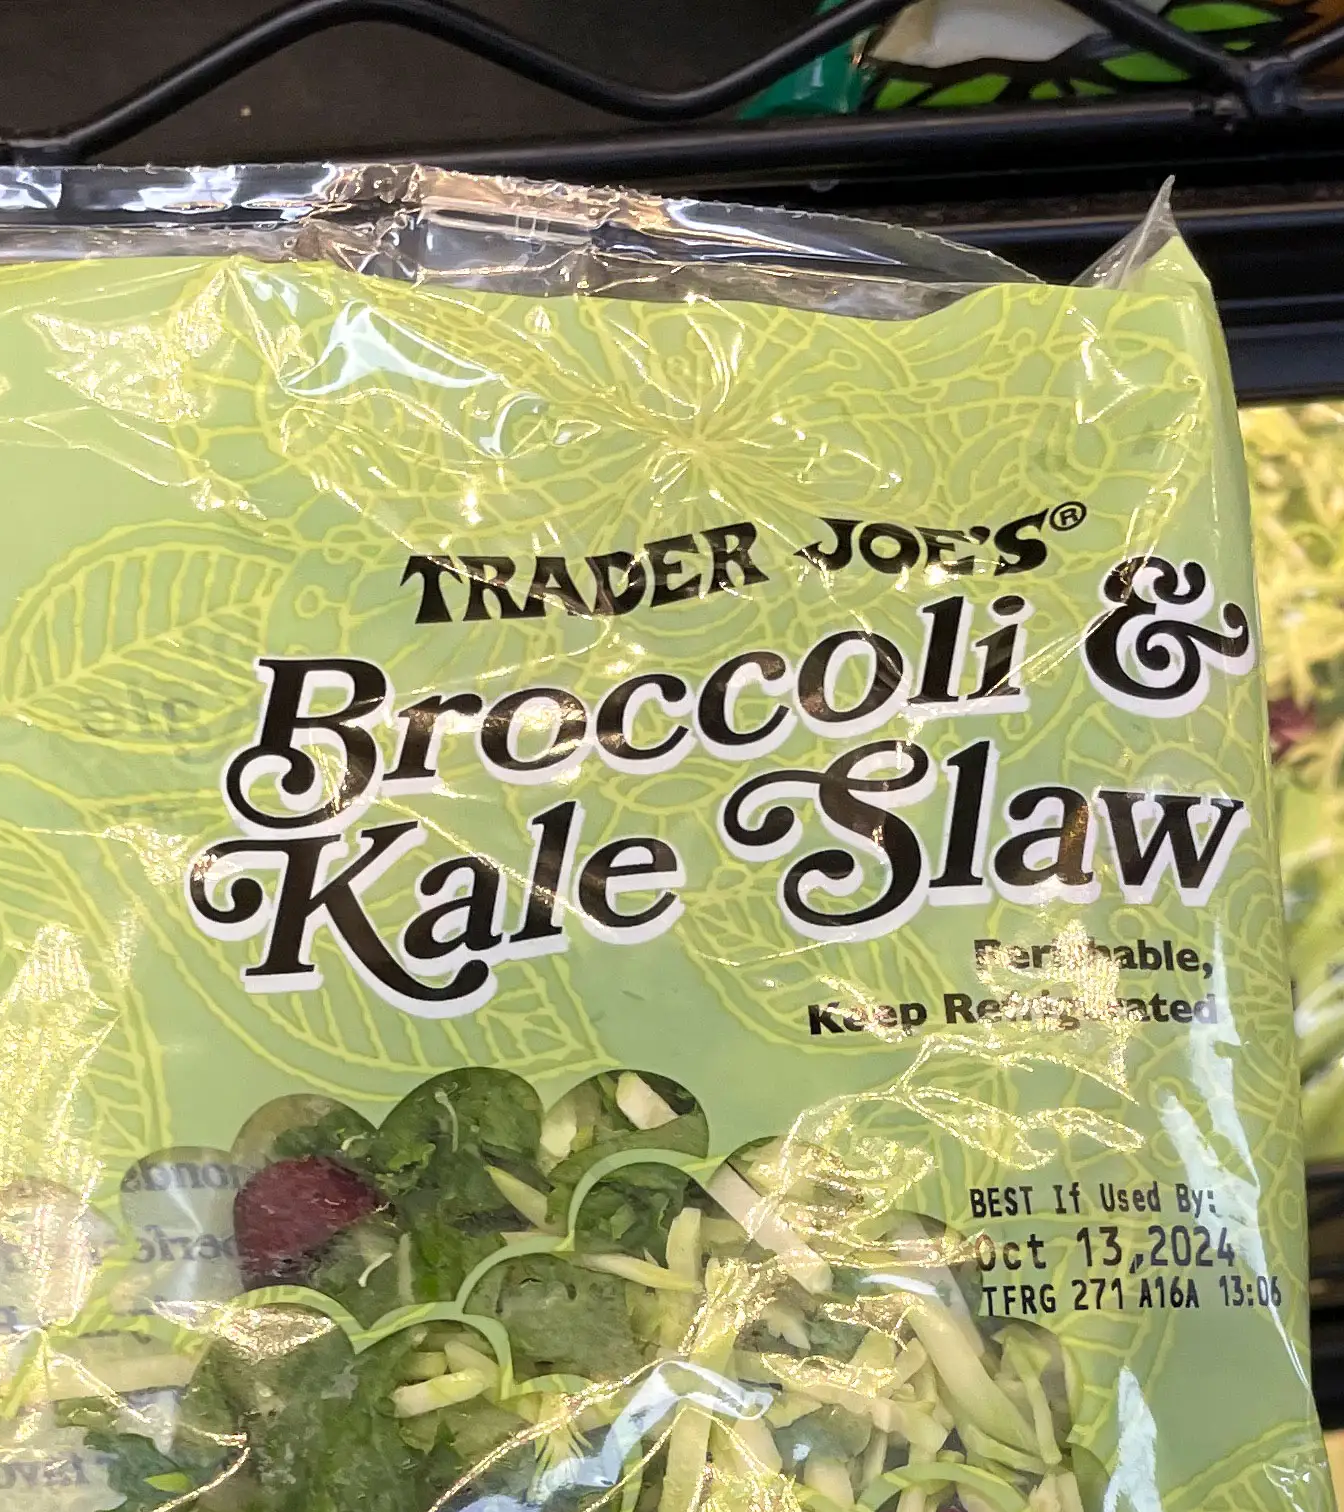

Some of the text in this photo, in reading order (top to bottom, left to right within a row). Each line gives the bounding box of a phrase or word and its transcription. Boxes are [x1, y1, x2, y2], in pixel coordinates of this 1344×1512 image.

[401, 521, 770, 625] TRADER
[226, 556, 1250, 830] Broccoli &
[193, 739, 1246, 1003] Kale Slaw
[973, 939, 1213, 979] Perable,
[808, 999, 928, 1036] Keep
[969, 1181, 1216, 1218] BEST If Used By:
[976, 1233, 1047, 1272] Oct
[982, 1283, 1057, 1316] TFRG
[1071, 1277, 1125, 1311] 271
[1139, 1277, 1201, 1309] A16A
